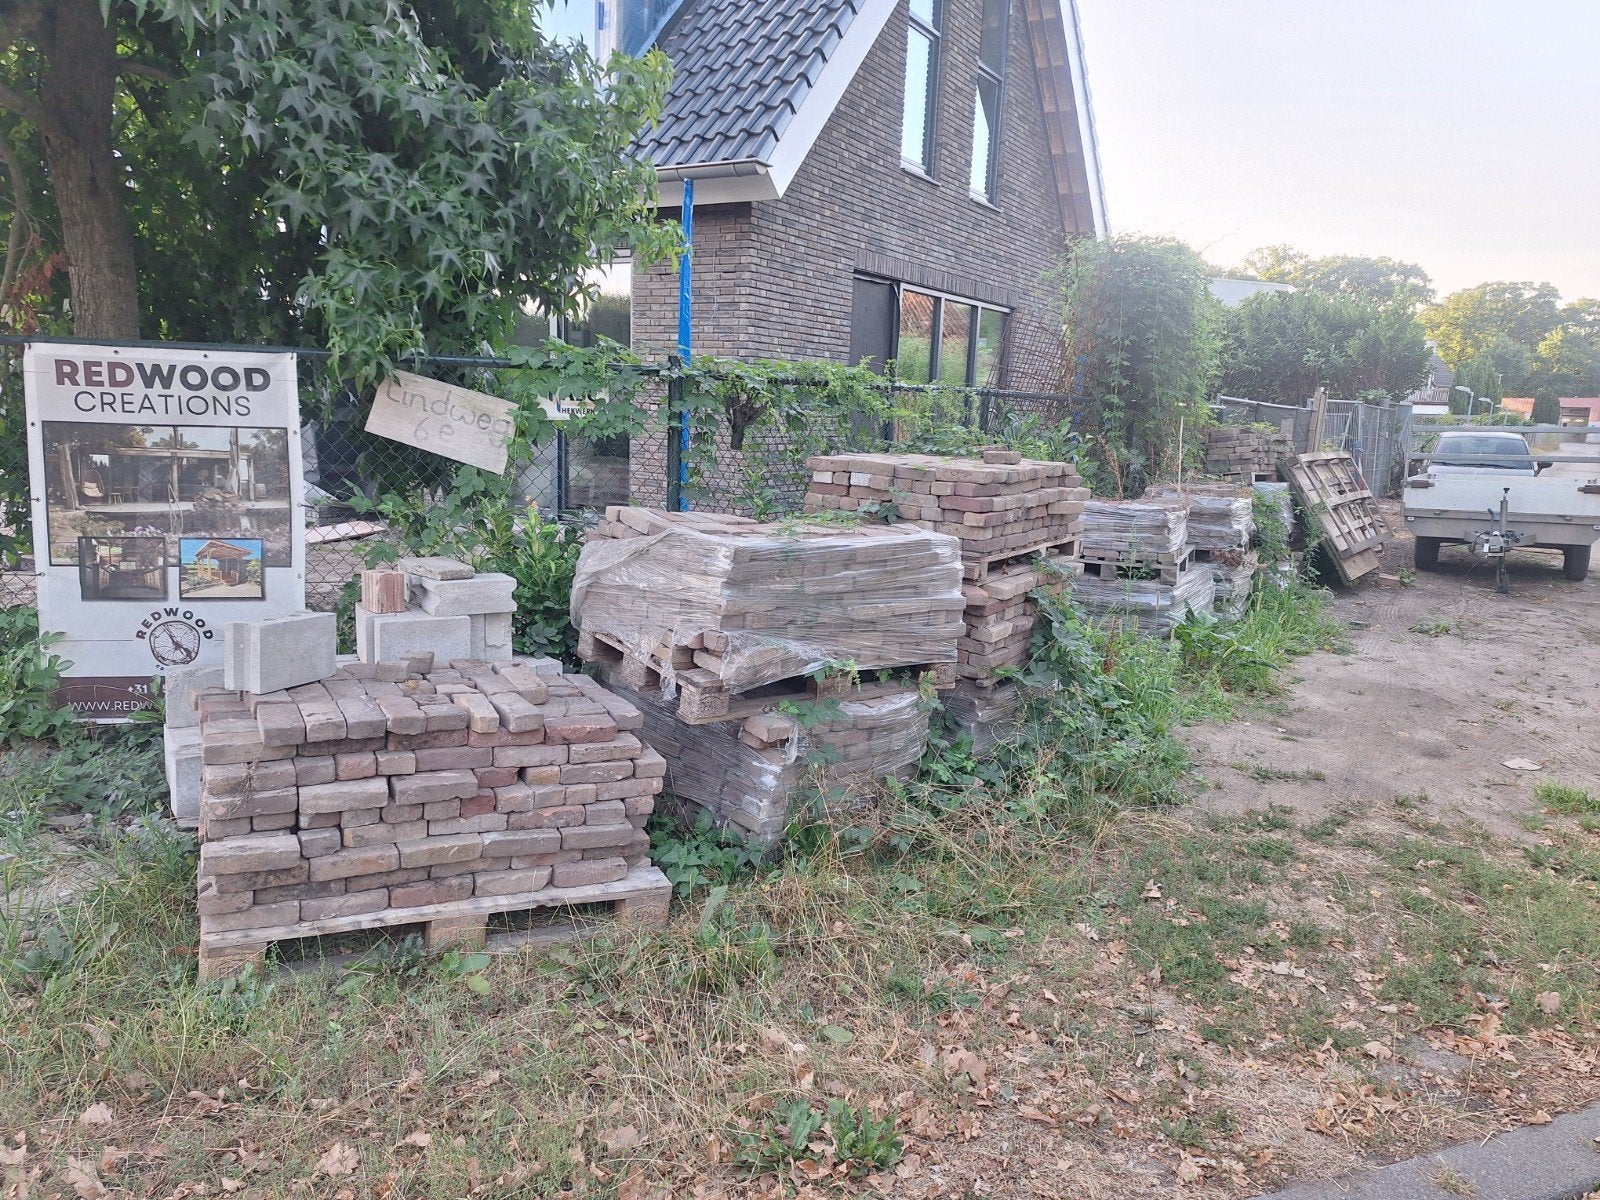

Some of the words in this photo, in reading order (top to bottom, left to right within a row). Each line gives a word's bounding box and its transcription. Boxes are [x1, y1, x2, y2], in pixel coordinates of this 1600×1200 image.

[54, 358, 271, 392] REDWOOD
[74, 390, 251, 417] CREATIONS
[135, 607, 214, 640] REDWOOD
[68, 700, 153, 711] WWW.REDW
